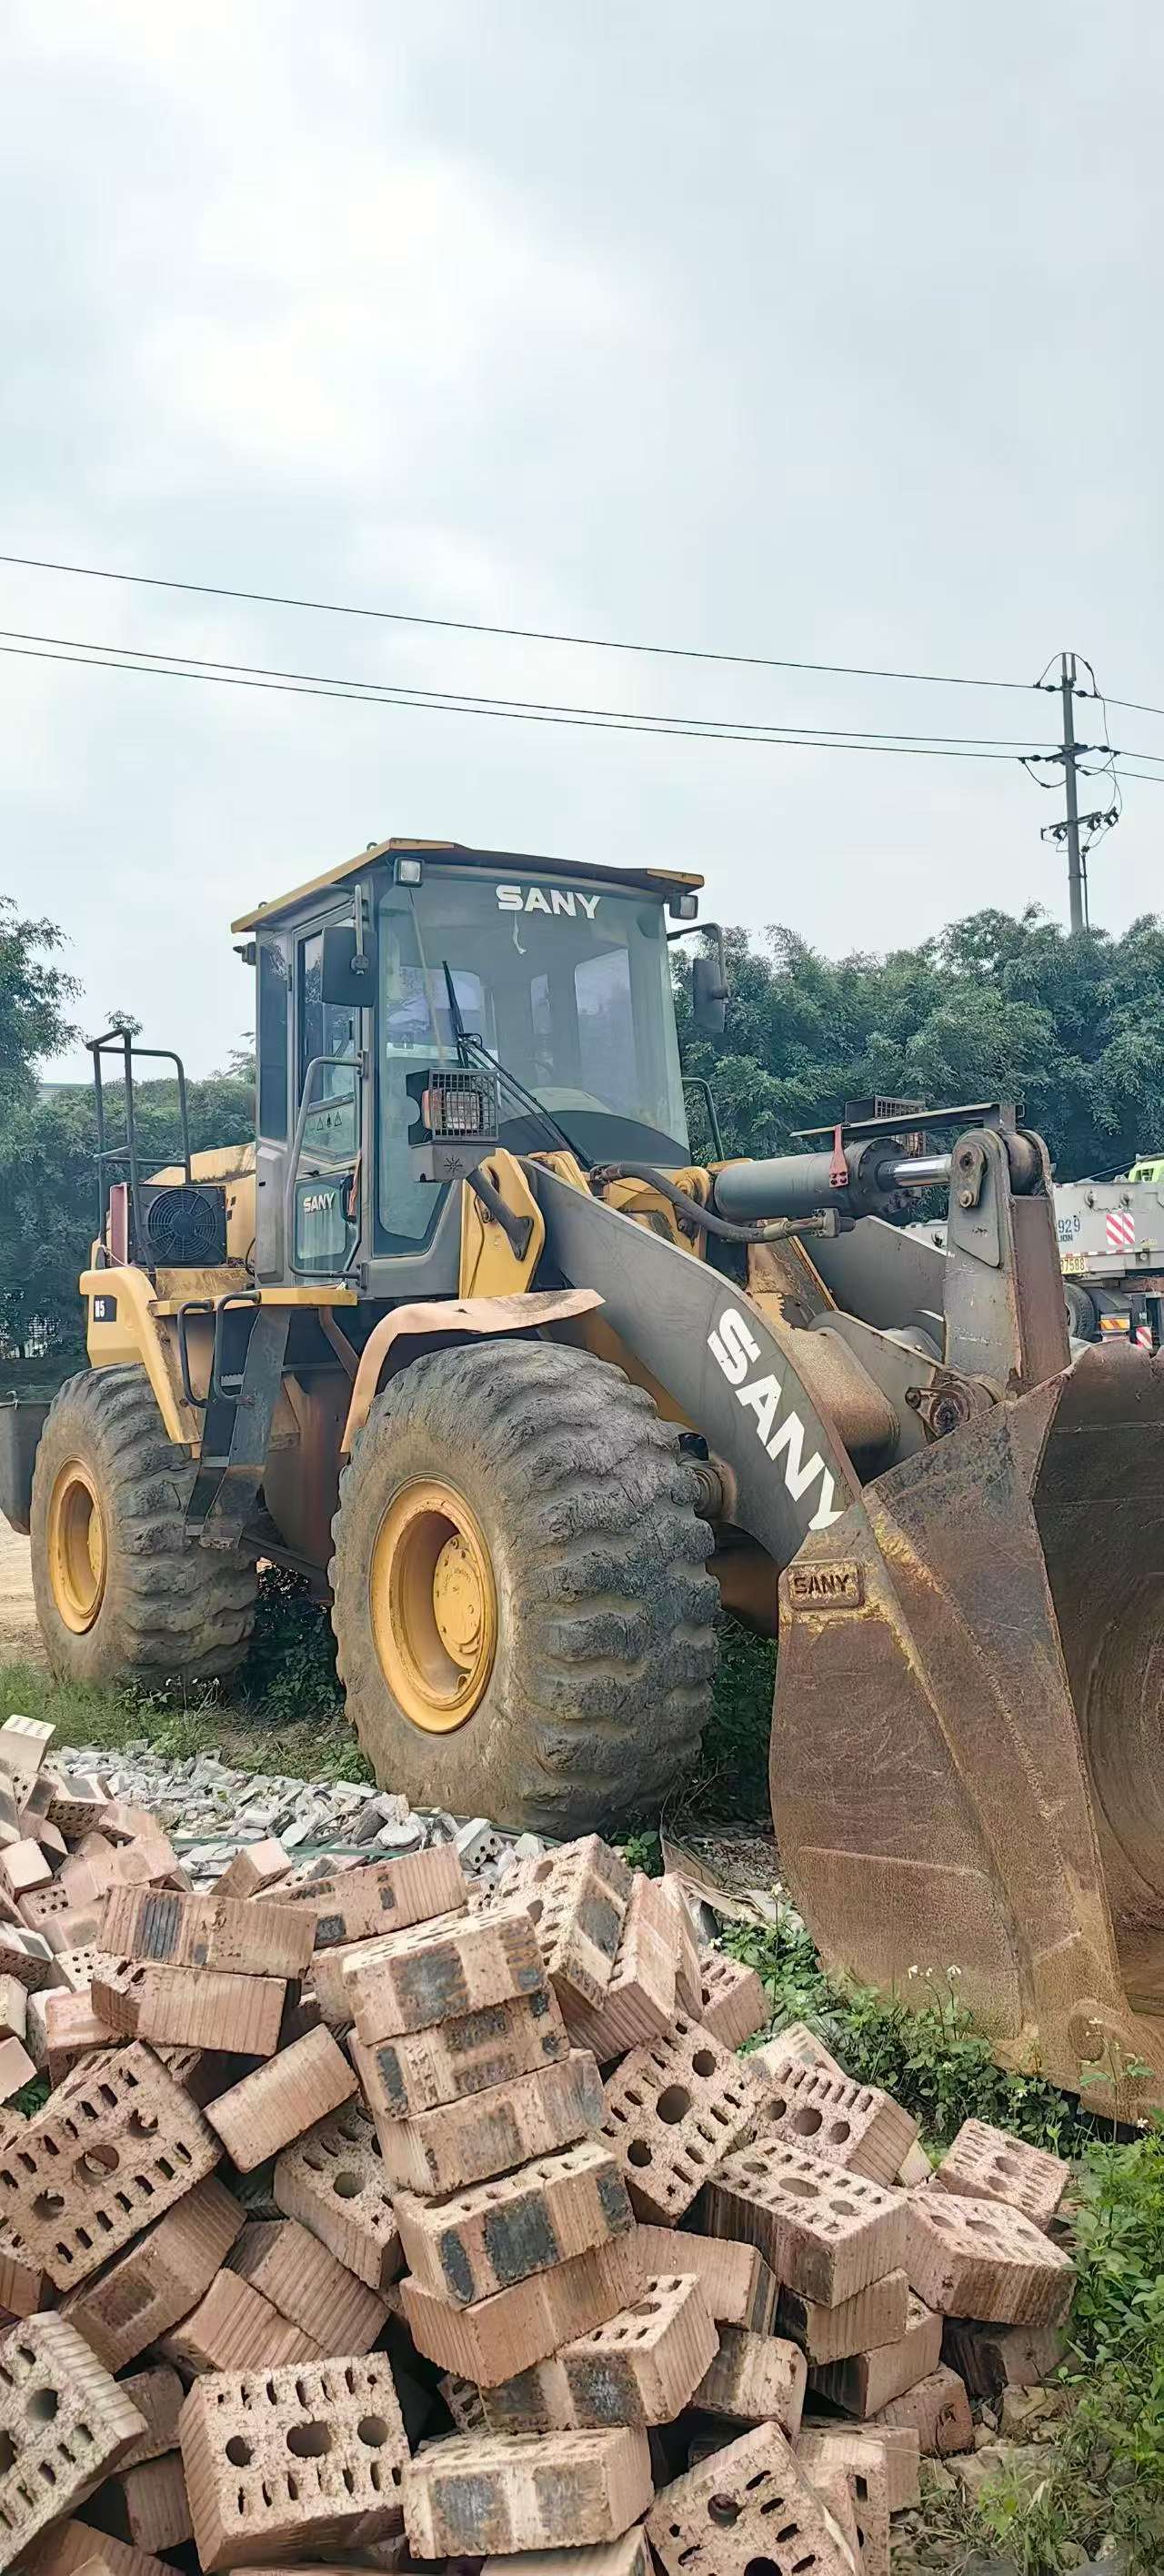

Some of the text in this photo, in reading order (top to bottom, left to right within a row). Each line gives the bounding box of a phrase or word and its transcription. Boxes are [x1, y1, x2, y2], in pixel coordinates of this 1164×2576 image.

[496, 885, 600, 920] SANY
[304, 1192, 335, 1213] SANY
[707, 1308, 845, 1531] SANY
[794, 1574, 849, 1595] SANY
